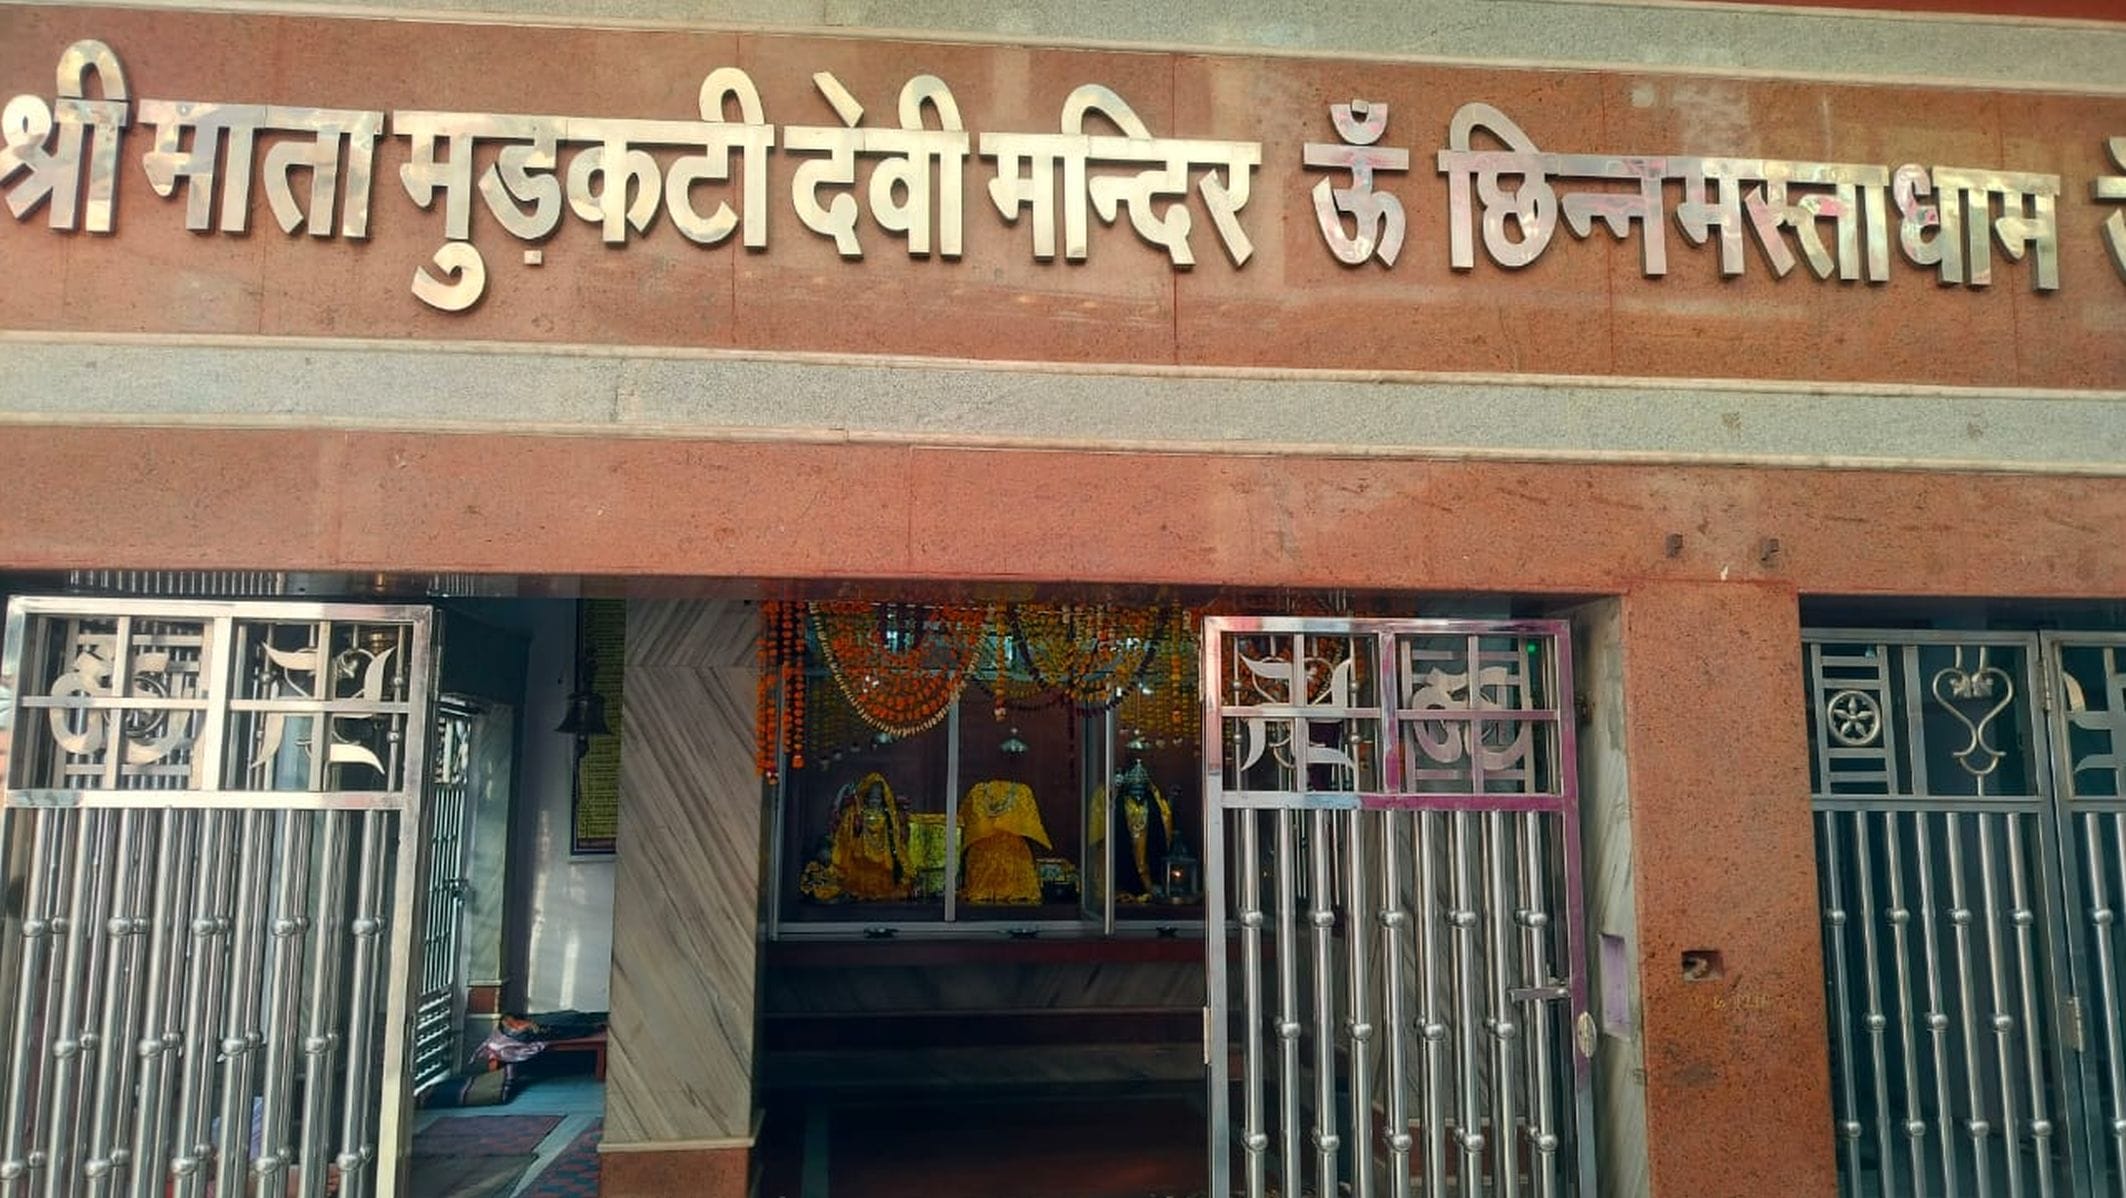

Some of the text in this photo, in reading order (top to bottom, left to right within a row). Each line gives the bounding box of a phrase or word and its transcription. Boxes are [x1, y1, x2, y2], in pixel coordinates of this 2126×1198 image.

[0, 38, 131, 232] श्री
[137, 99, 384, 239] माता
[393, 66, 775, 312] मुड़कटी
[783, 71, 970, 258] देवी
[979, 84, 1262, 267] मन्दिर
